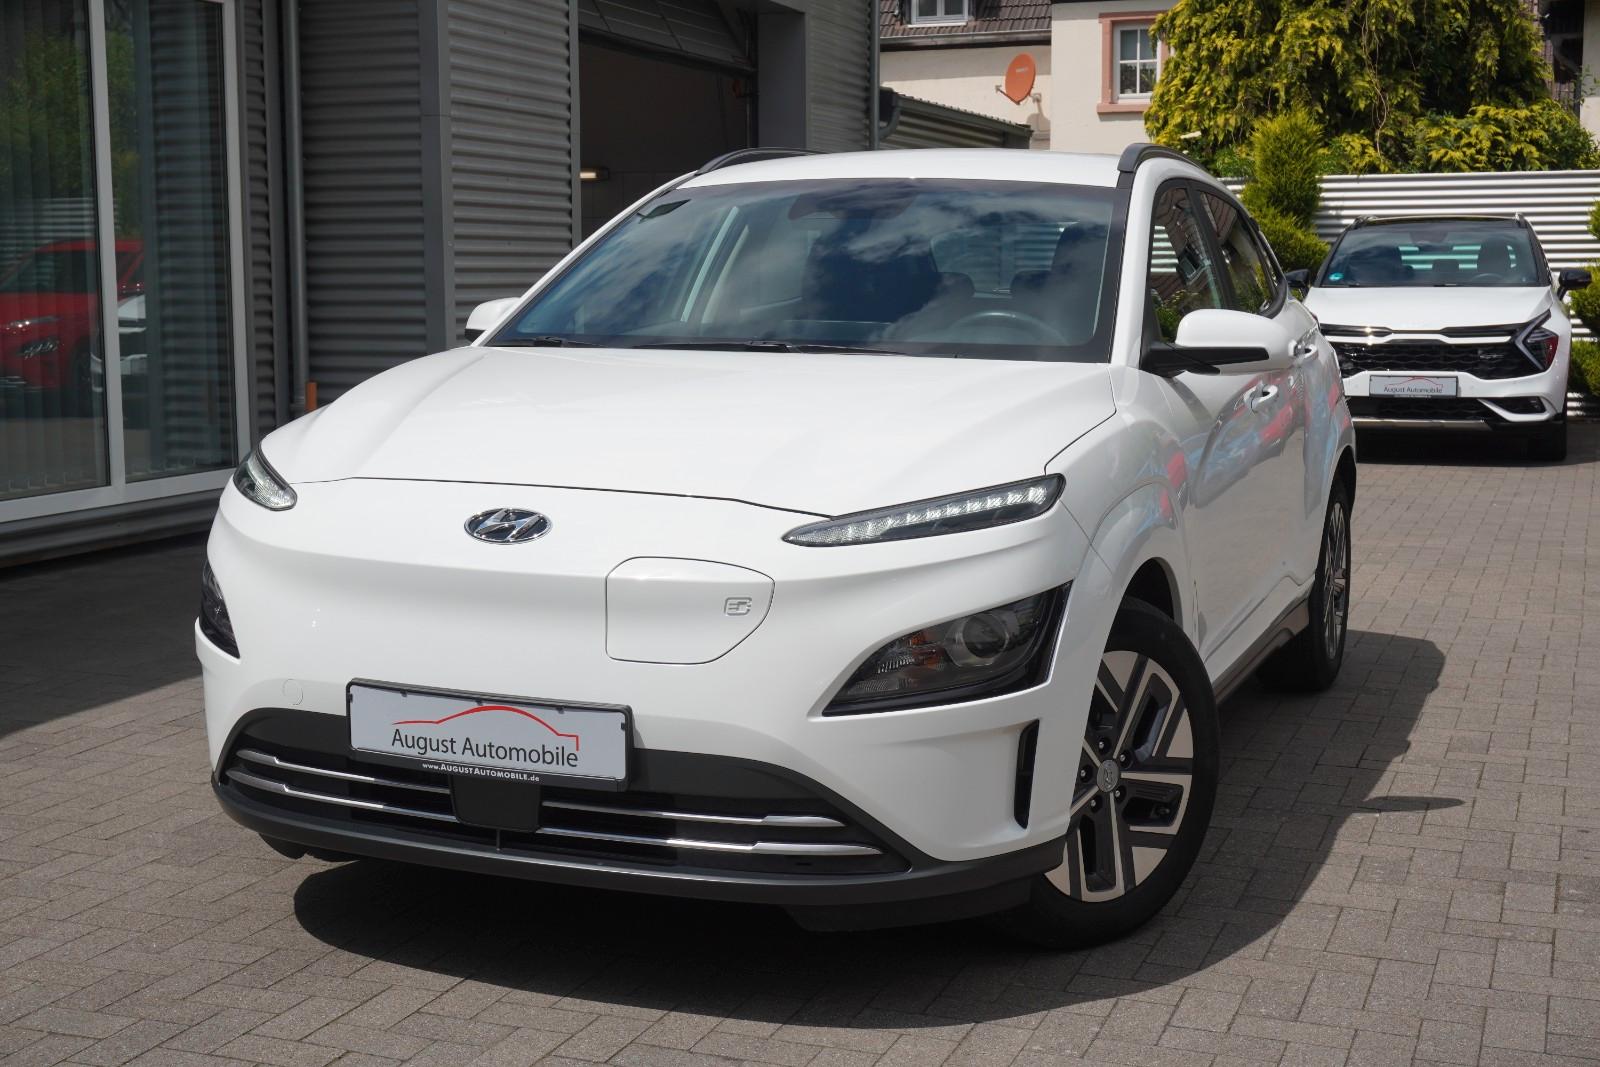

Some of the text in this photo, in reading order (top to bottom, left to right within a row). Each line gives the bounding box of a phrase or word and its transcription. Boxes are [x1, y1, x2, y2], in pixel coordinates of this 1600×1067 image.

[1384, 385, 1443, 394] August Automobile
[391, 728, 578, 768] August Automobile
